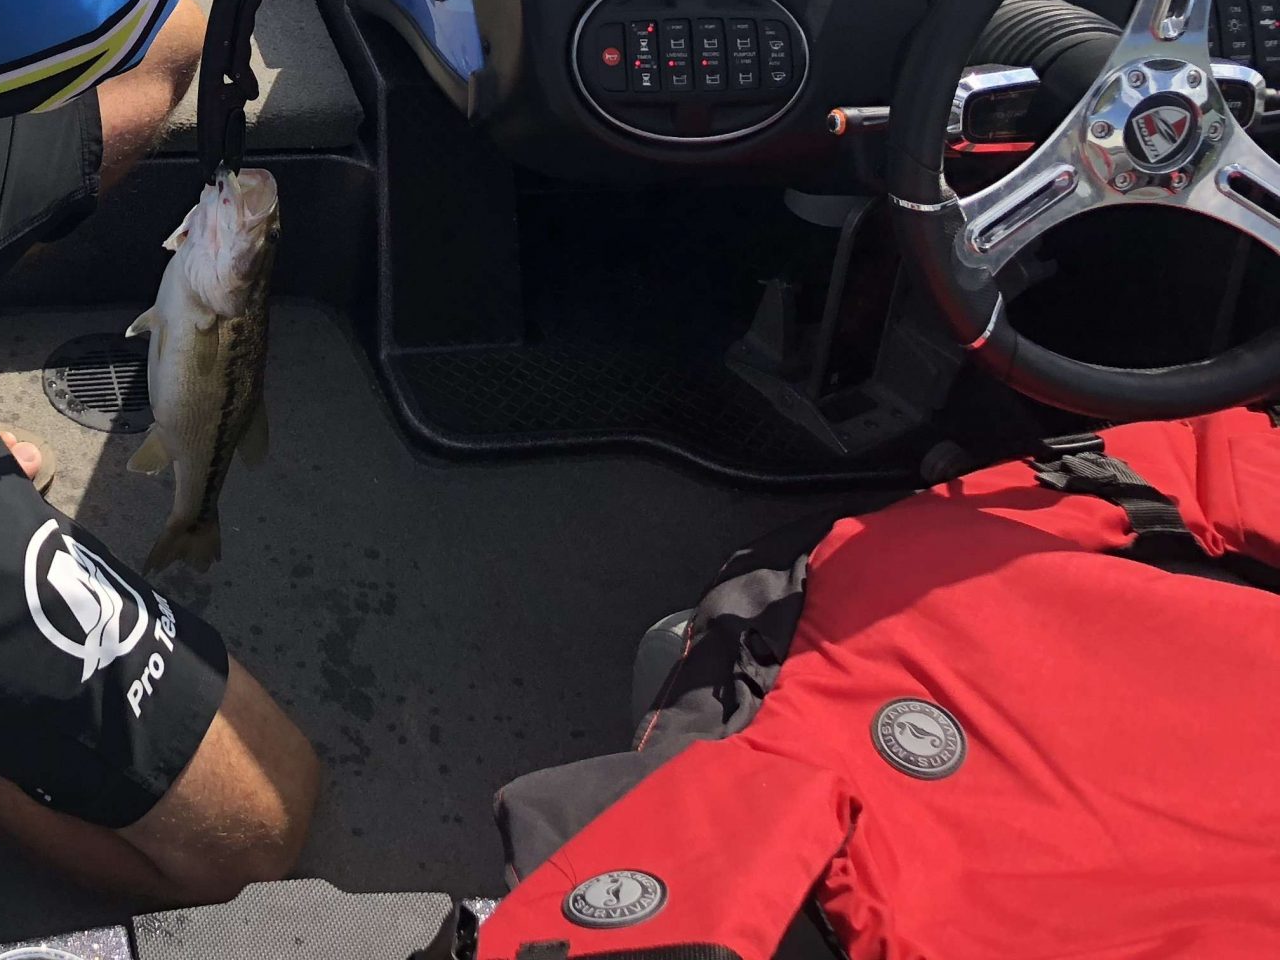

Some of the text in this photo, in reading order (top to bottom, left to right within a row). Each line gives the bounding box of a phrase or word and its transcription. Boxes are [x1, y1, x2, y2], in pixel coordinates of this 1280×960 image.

[127, 652, 165, 718] Pro
[881, 703, 922, 759] MUSTANG
[917, 709, 957, 767] SURVIVAL
[574, 889, 656, 919] SURVIVAL
